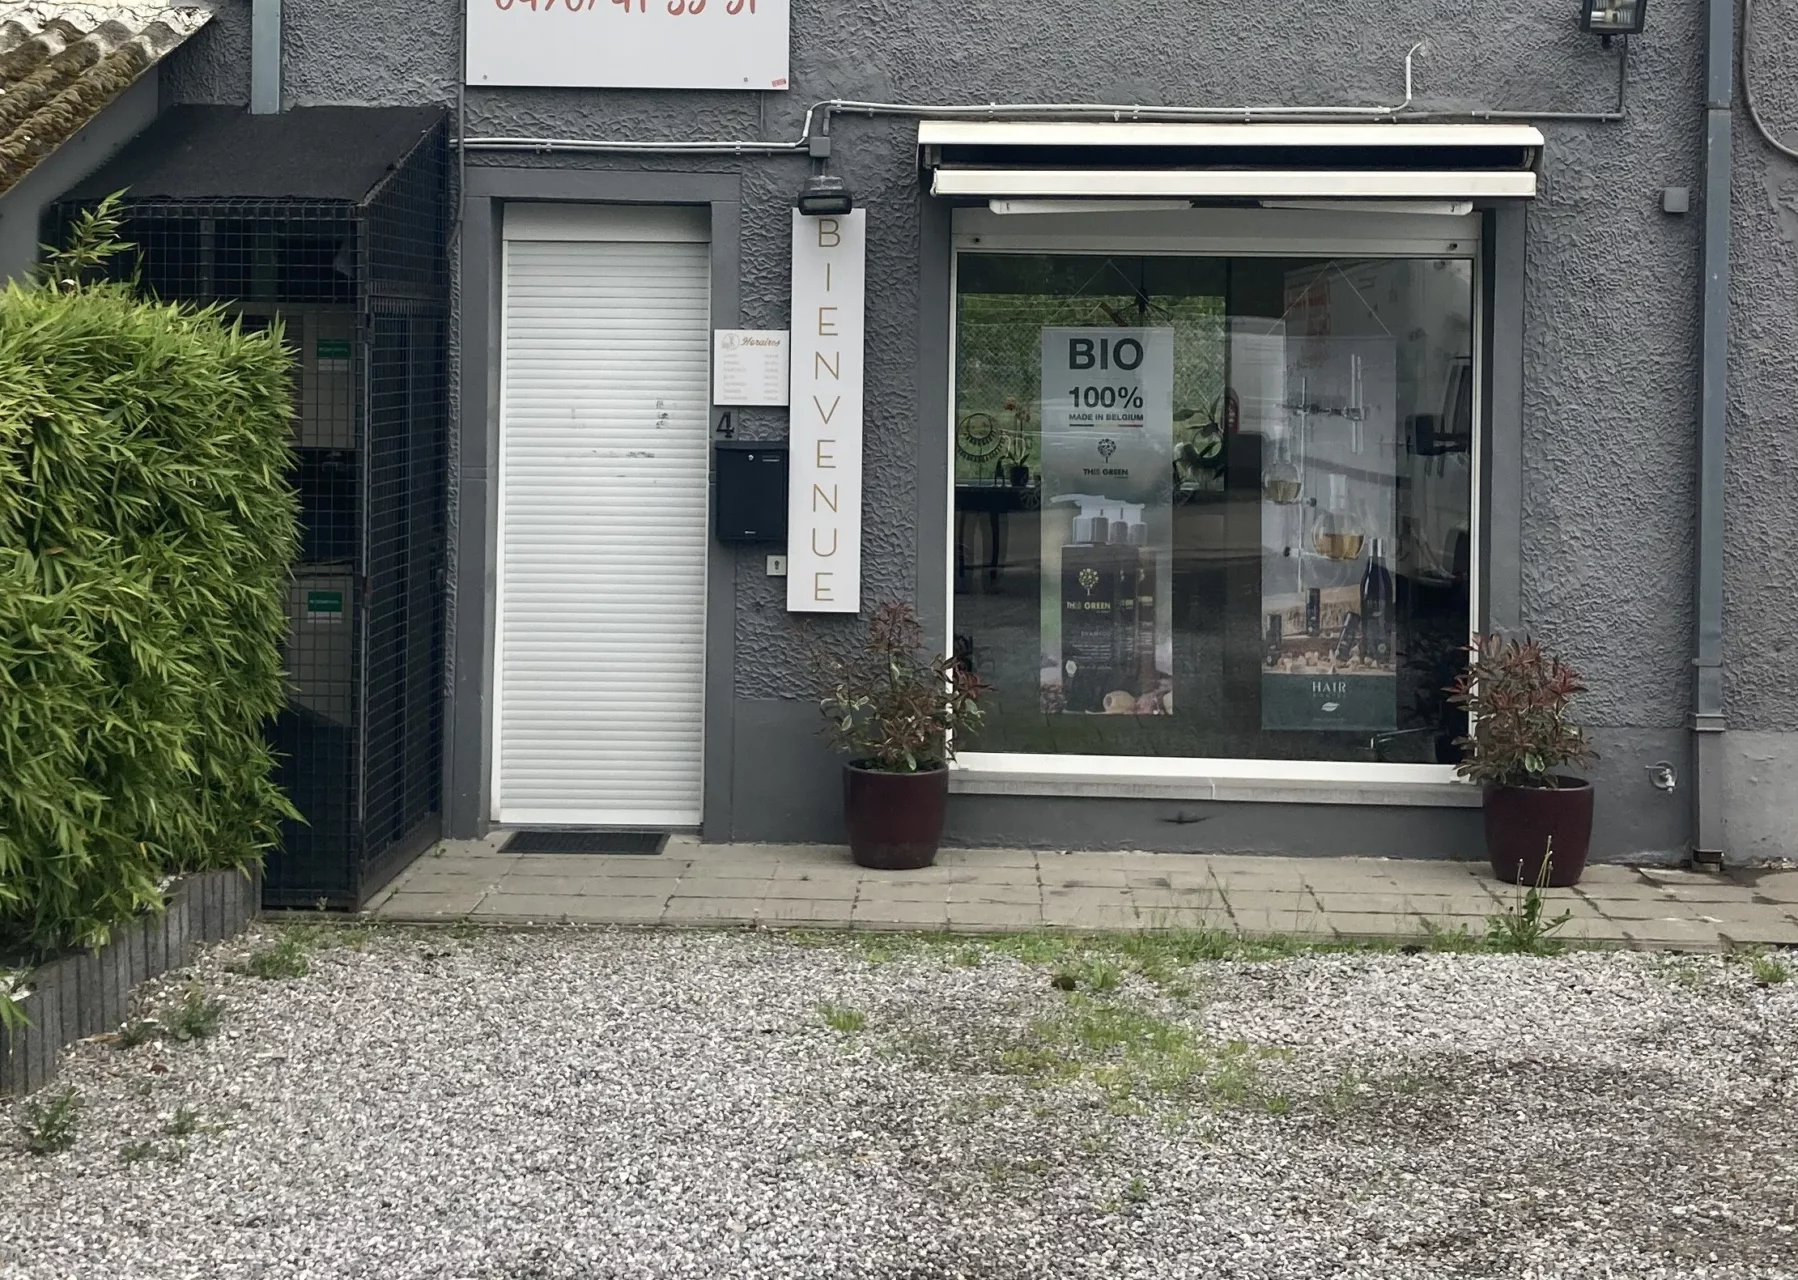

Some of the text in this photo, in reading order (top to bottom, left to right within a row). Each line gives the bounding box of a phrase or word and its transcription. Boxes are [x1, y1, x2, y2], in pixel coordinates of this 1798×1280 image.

[740, 336, 781, 347] Horaires
[1069, 337, 1144, 371] BIO
[1069, 386, 1144, 409] 100%
[812, 219, 842, 602] BIENVENUE
[716, 411, 735, 439] 4
[1102, 468, 1129, 476] GREEN
[1084, 601, 1111, 610] GREEN
[1312, 681, 1347, 693] HAIR
